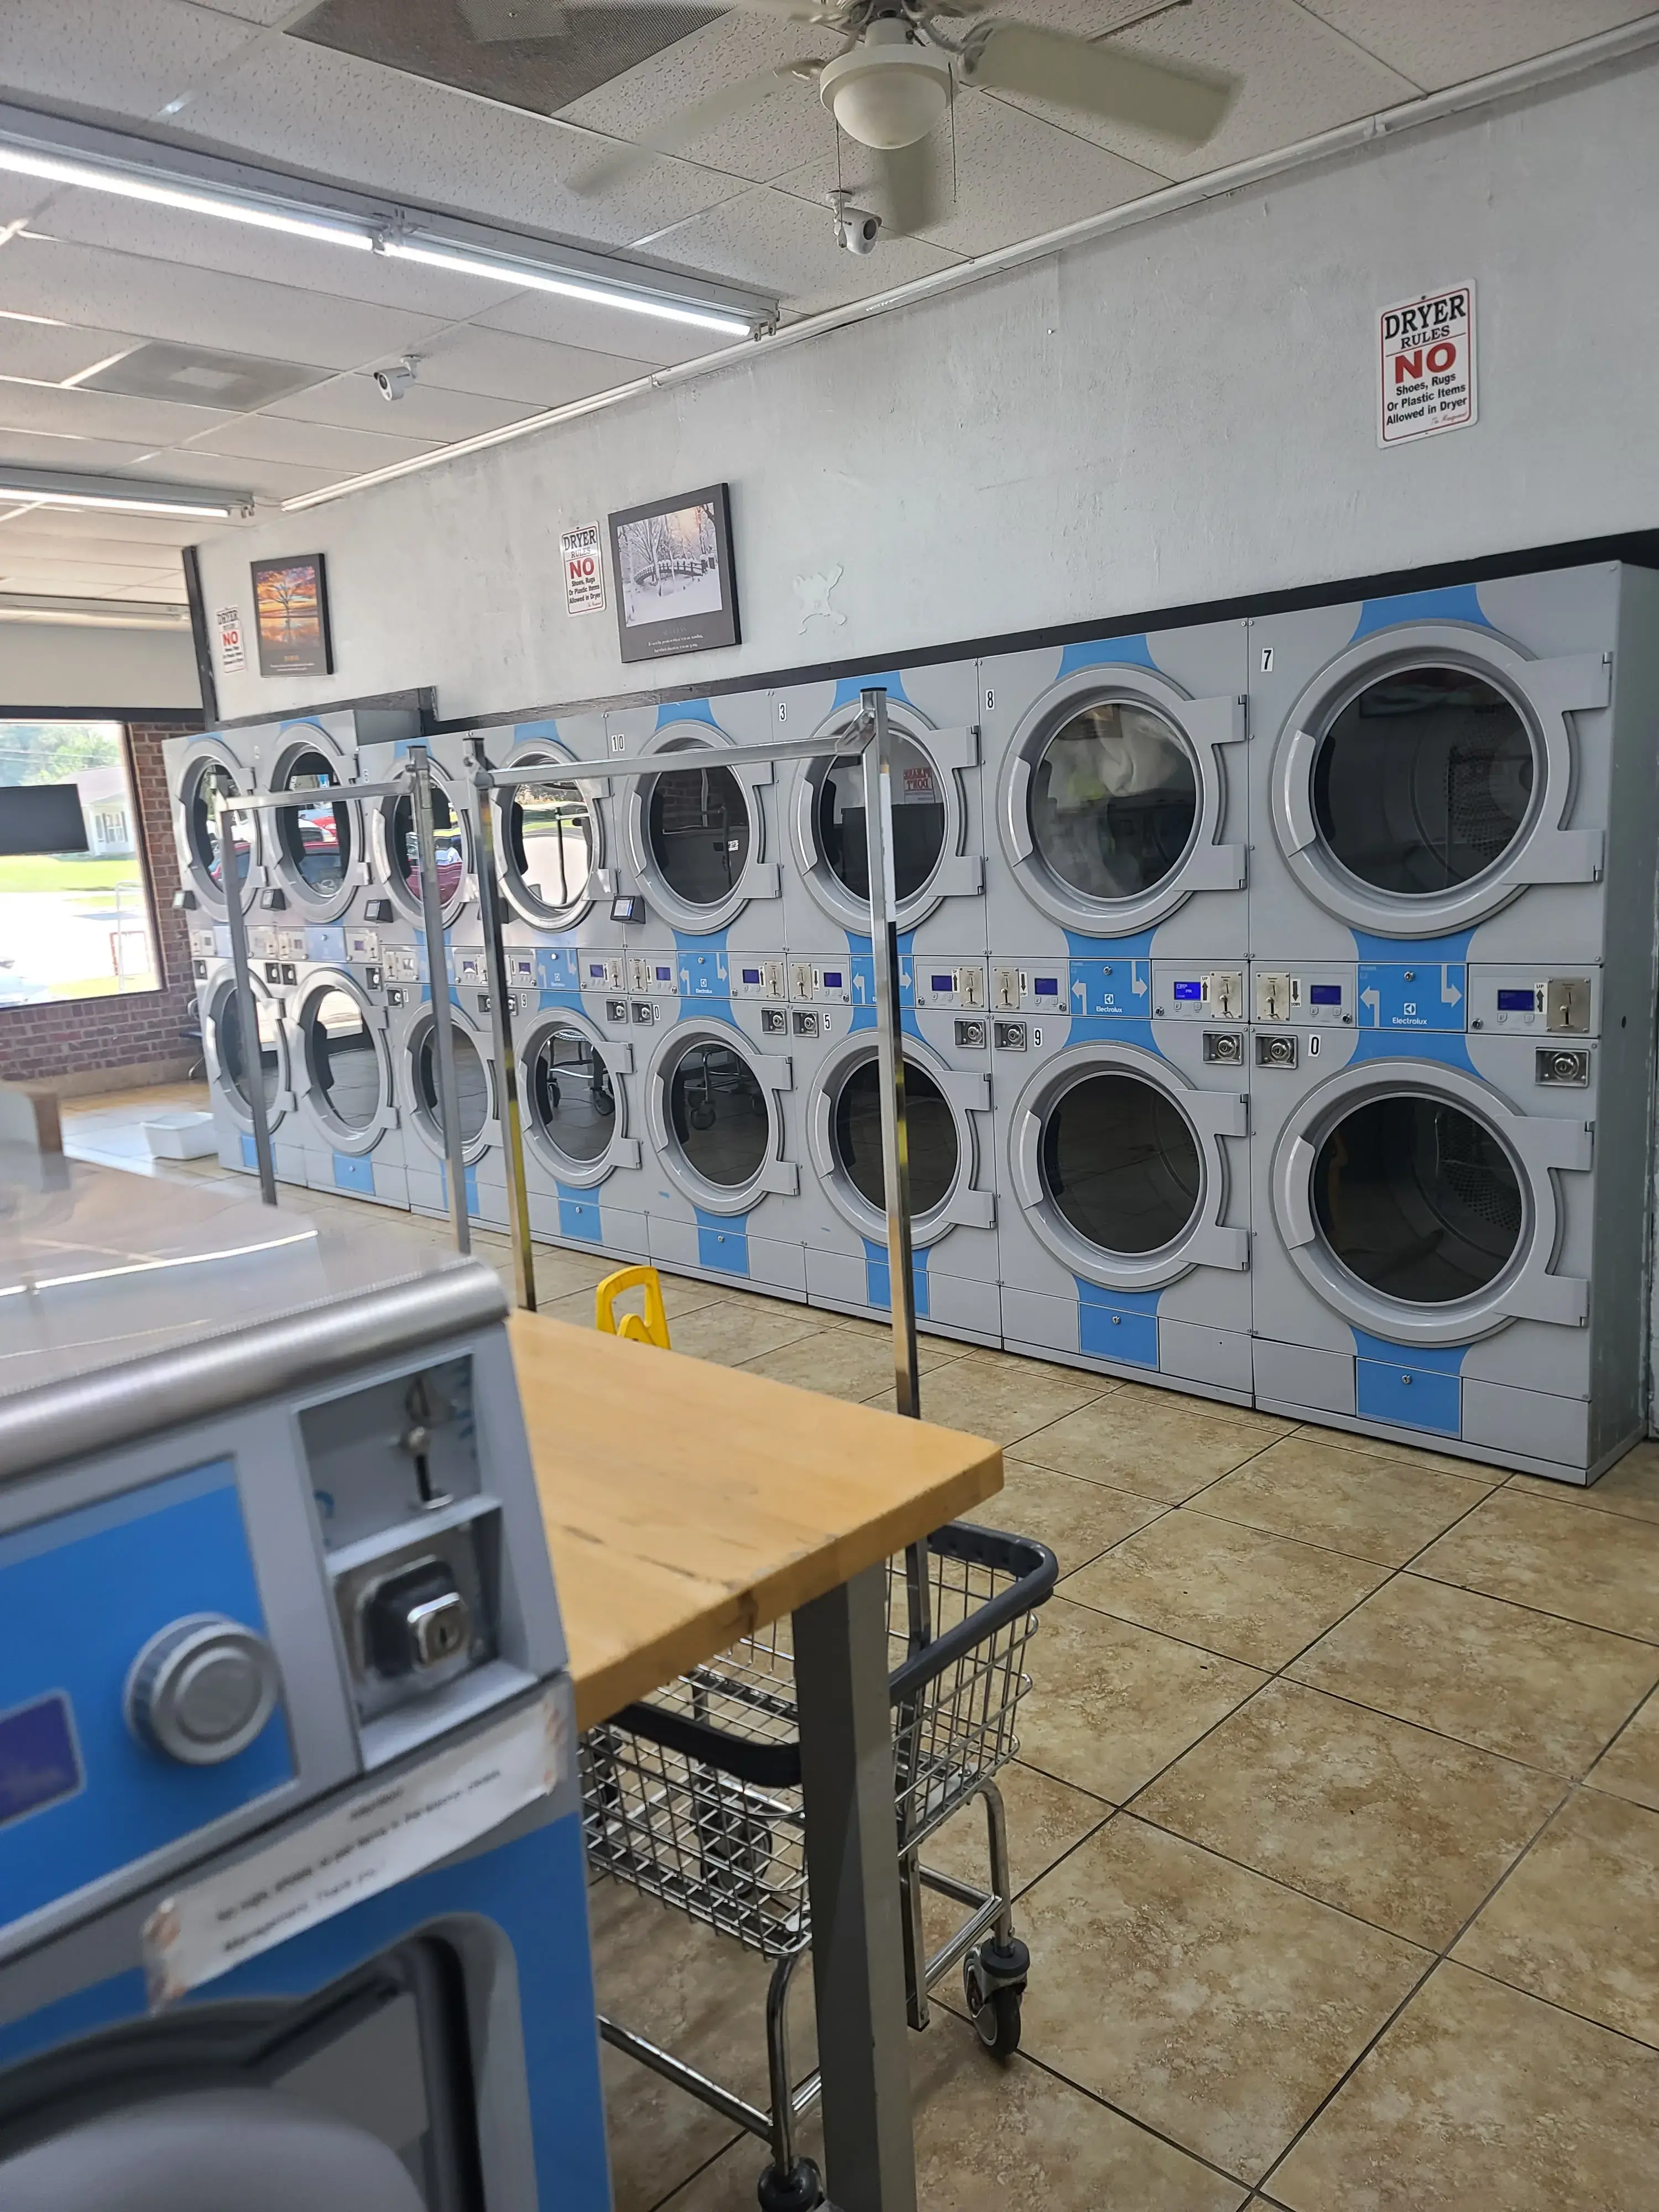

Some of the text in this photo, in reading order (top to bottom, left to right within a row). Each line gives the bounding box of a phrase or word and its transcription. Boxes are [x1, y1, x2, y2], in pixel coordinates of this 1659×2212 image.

[1385, 294, 1467, 340] DRYER
[1401, 325, 1450, 349] RULES
[1395, 342, 1456, 384] NO
[1396, 372, 1456, 396] Shoes, Rugs
[1387, 384, 1466, 411] Or Plastic Items
[1386, 407, 1424, 425] Allowed
[1428, 405, 1437, 414] in
[1440, 397, 1467, 412] Dryer
[563, 529, 596, 551] DRYER
[571, 547, 591, 559] RULES
[570, 557, 594, 579] NO
[570, 595, 585, 604] Allowed
[590, 592, 601, 601] Dryer
[574, 587, 587, 595] Plastic
[222, 631, 238, 646] NO
[1264, 649, 1272, 670] 7
[987, 691, 993, 708] 8
[780, 705, 785, 720] 3
[613, 735, 624, 750] 10
[825, 1014, 830, 1029] 5
[1035, 1029, 1041, 1046] 9
